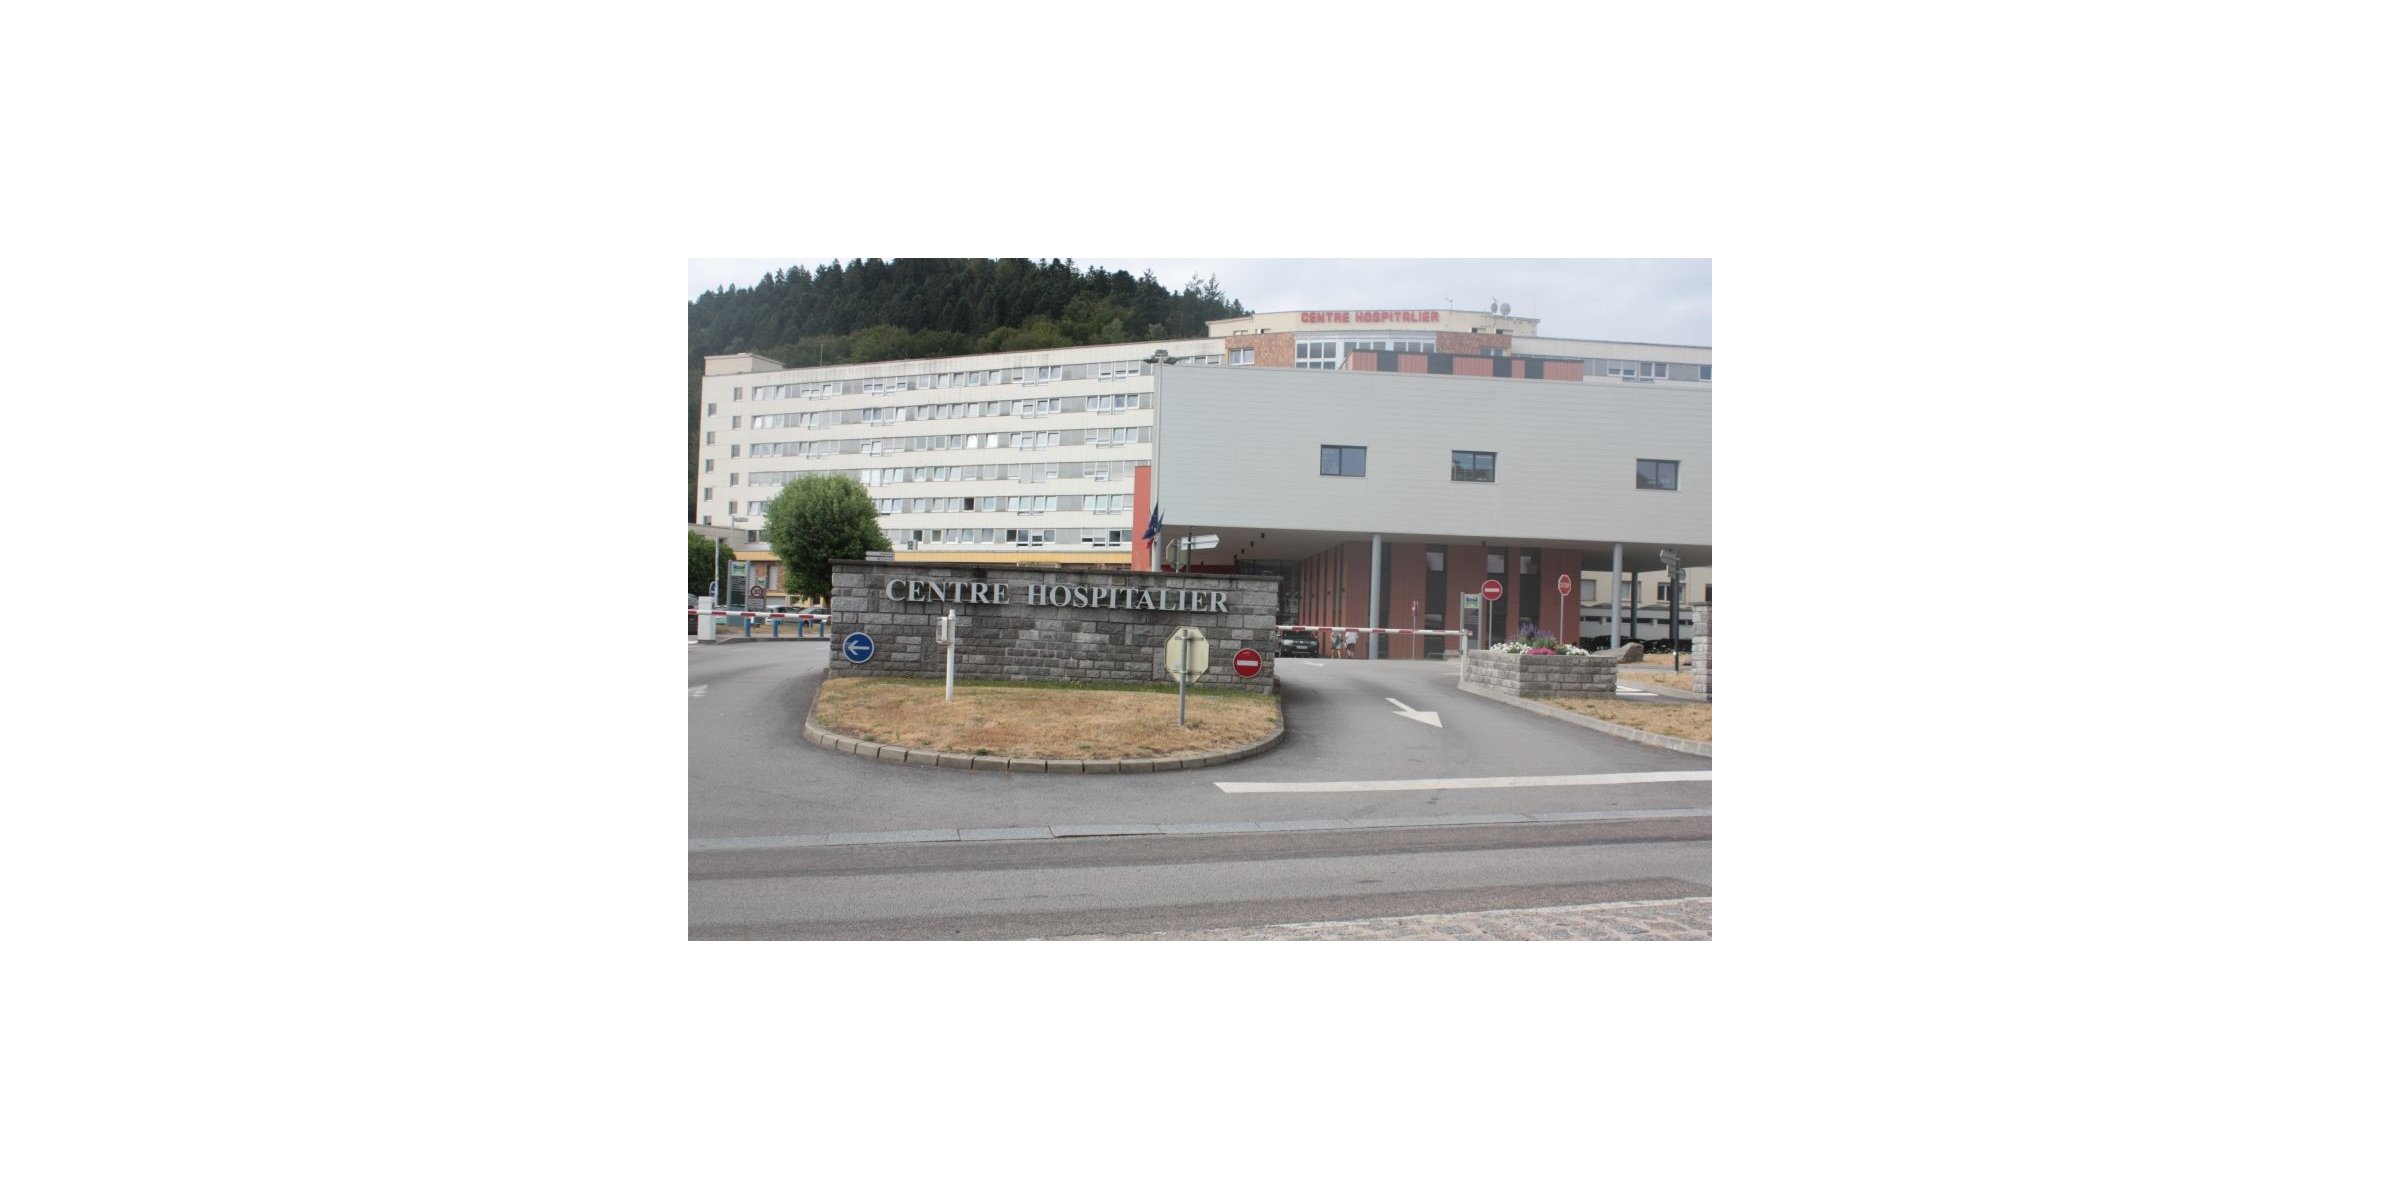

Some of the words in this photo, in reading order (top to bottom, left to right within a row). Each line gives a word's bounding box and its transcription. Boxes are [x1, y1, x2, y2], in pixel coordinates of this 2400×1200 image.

[1301, 311, 1349, 323] CENTRE
[1355, 311, 1439, 323] HOSPITALIER
[885, 579, 1010, 605] CENTRE
[1028, 583, 1229, 613] HOSPITALIER
